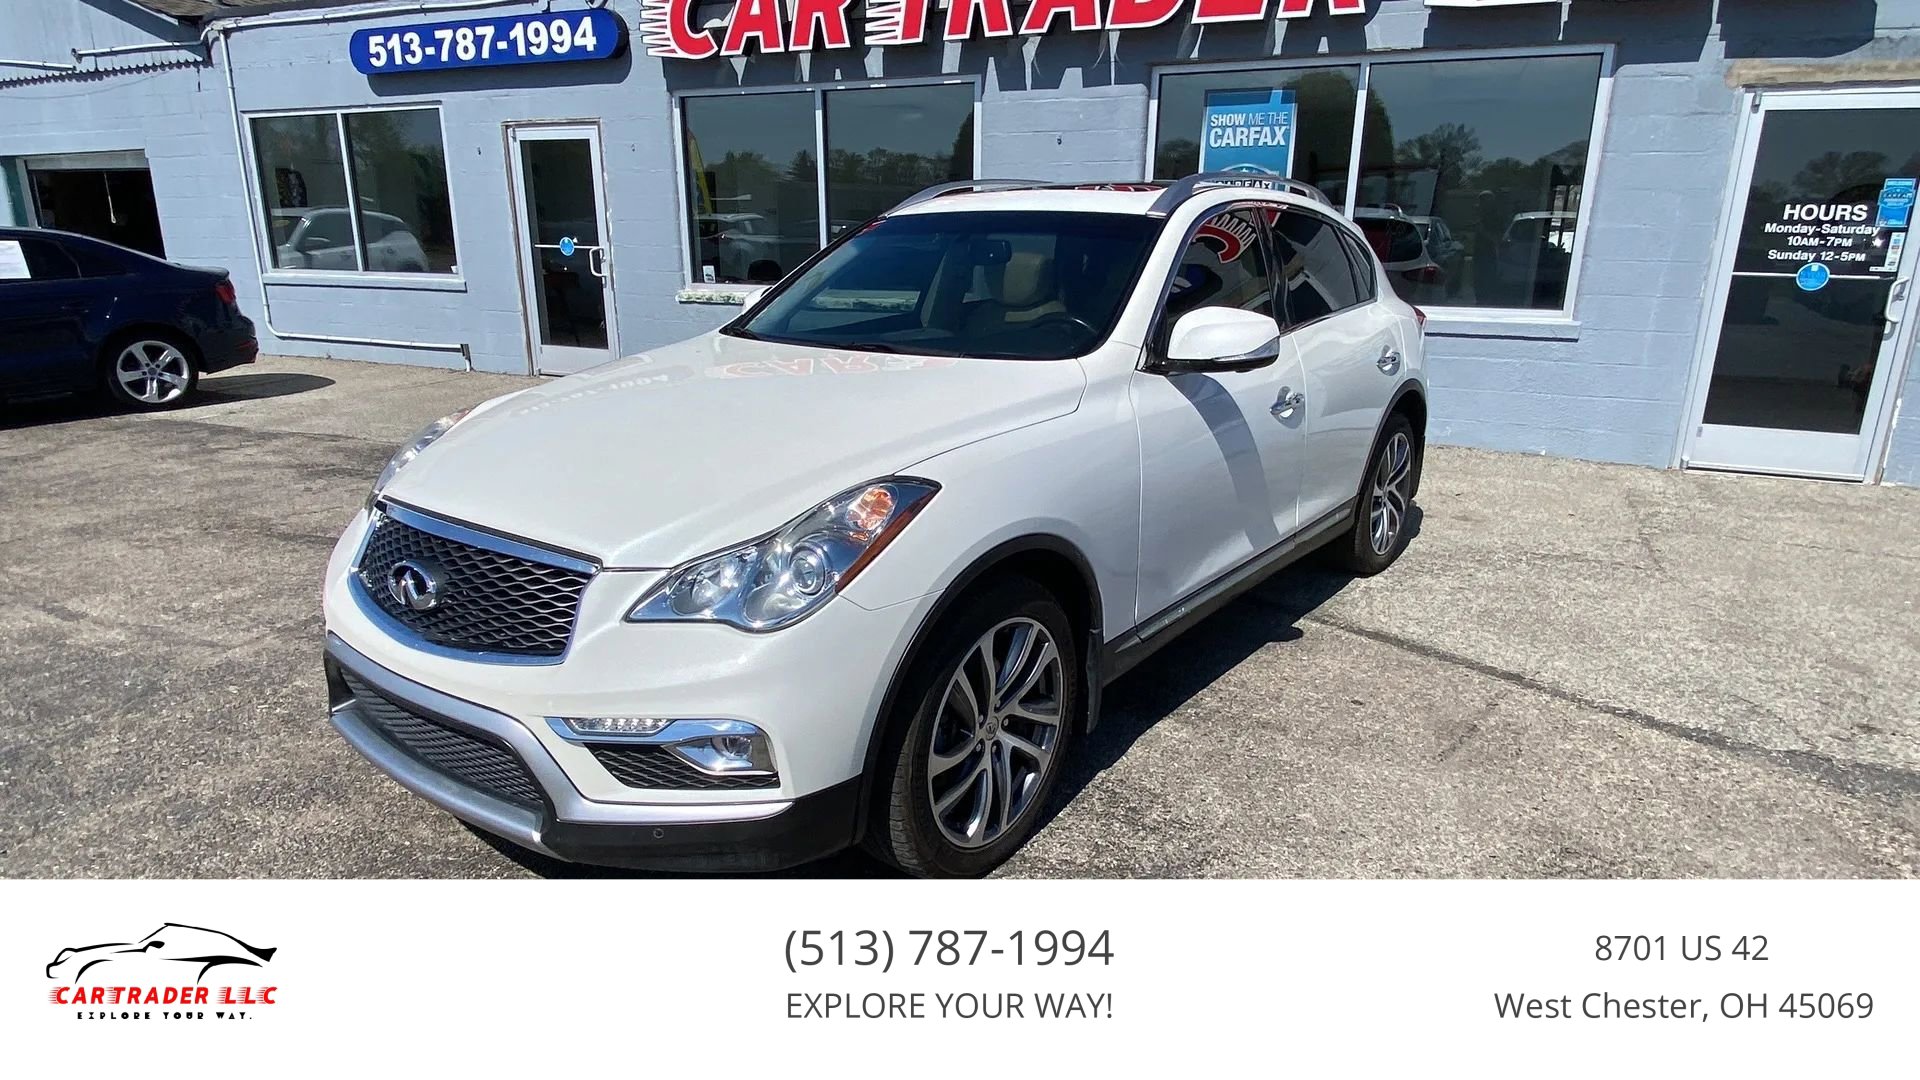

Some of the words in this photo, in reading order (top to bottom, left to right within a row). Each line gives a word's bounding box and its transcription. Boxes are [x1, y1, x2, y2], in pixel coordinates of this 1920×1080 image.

[368, 16, 597, 68] 513-787-1994
[1210, 113, 1246, 127] SHOW
[1248, 113, 1265, 125] ME
[1268, 111, 1289, 125] THE
[1209, 126, 1287, 148] CARFAX
[1782, 204, 1868, 221] HOURS
[1764, 223, 1881, 236] Monday-Saturday
[1787, 236, 1853, 247] 10AM-7PM
[1767, 250, 1816, 262] Sunday
[1819, 251, 1866, 262] 12-5PM
